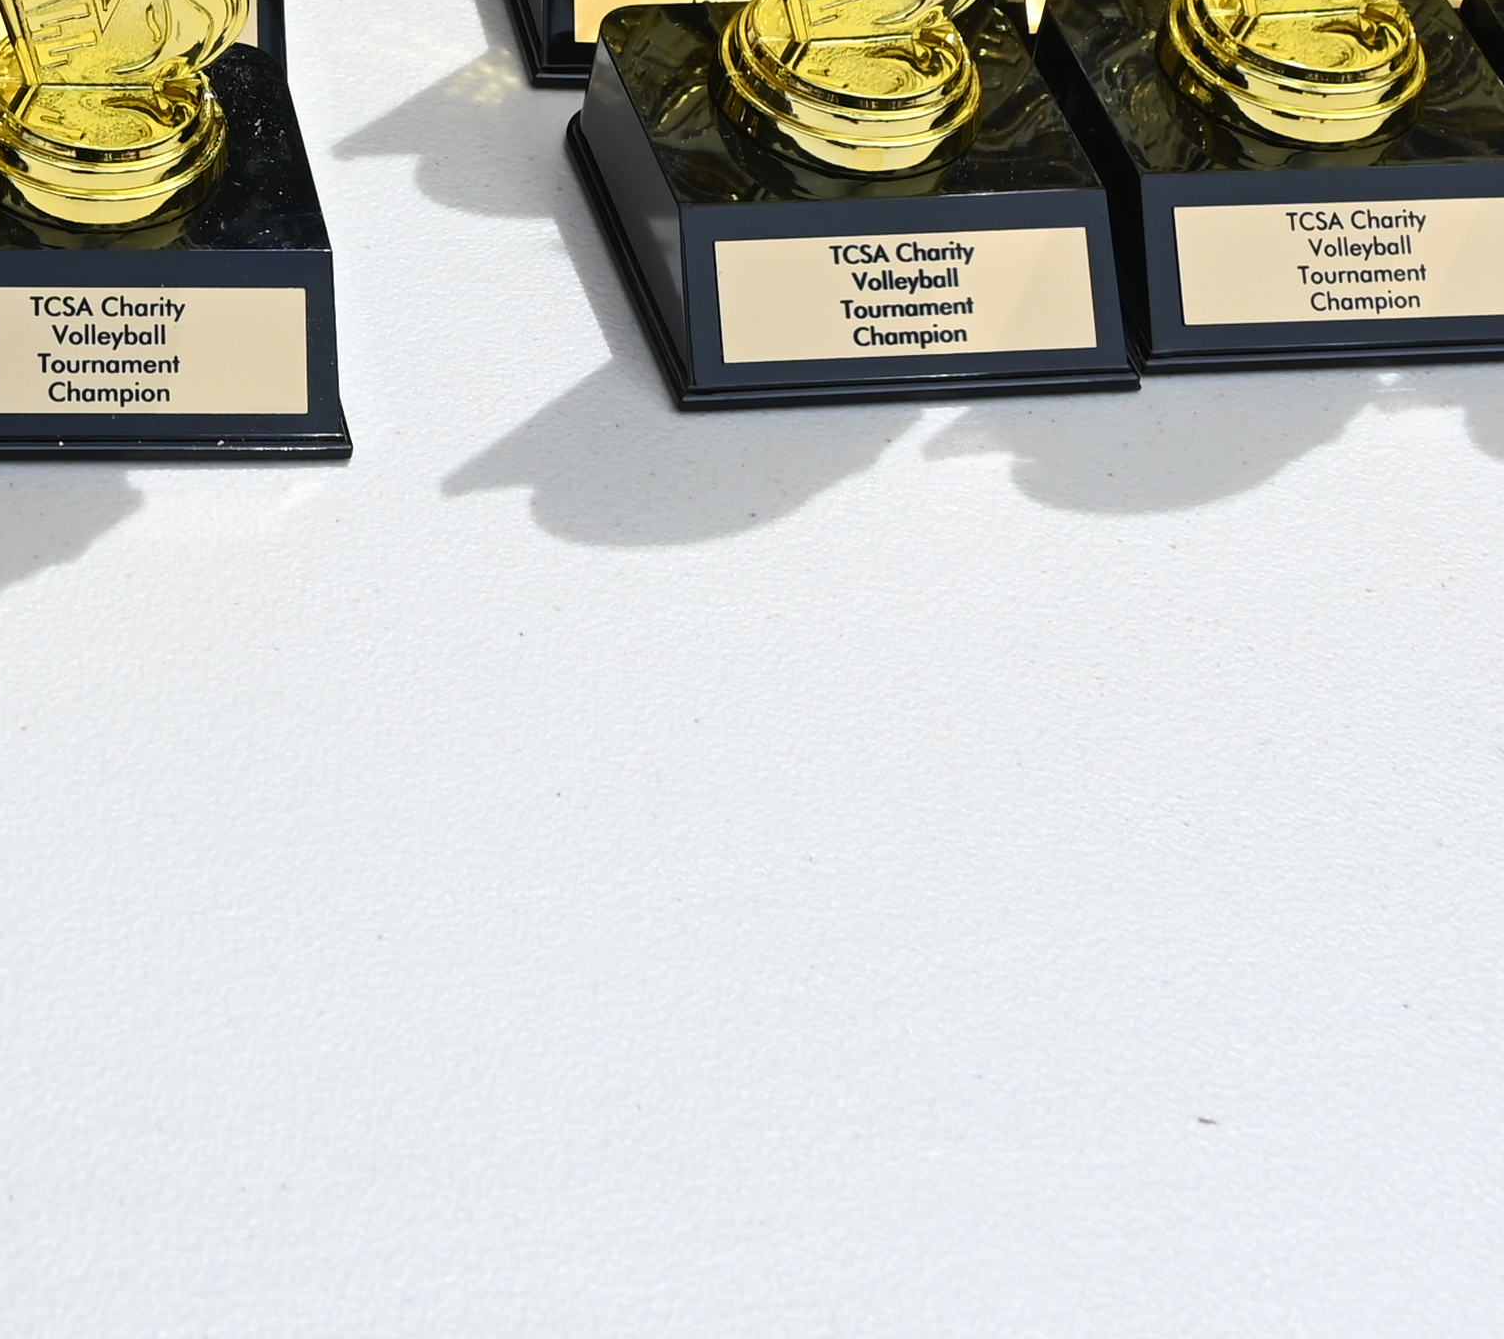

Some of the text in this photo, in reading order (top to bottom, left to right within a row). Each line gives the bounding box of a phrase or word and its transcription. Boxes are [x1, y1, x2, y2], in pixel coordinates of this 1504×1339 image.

[1285, 209, 1427, 233] TCSA Charity
[828, 240, 975, 265] TCSA Charity
[1307, 234, 1412, 262] Volleyball
[851, 267, 959, 295] Volleyball
[1296, 264, 1427, 285] Tournament
[29, 295, 186, 323] TCSA Charity
[839, 296, 974, 320] Tournament
[1310, 289, 1421, 315] Champion
[51, 323, 166, 351] Volleyball
[853, 323, 968, 350] Champion
[36, 352, 181, 374] Tournament
[48, 380, 170, 408] Champion
